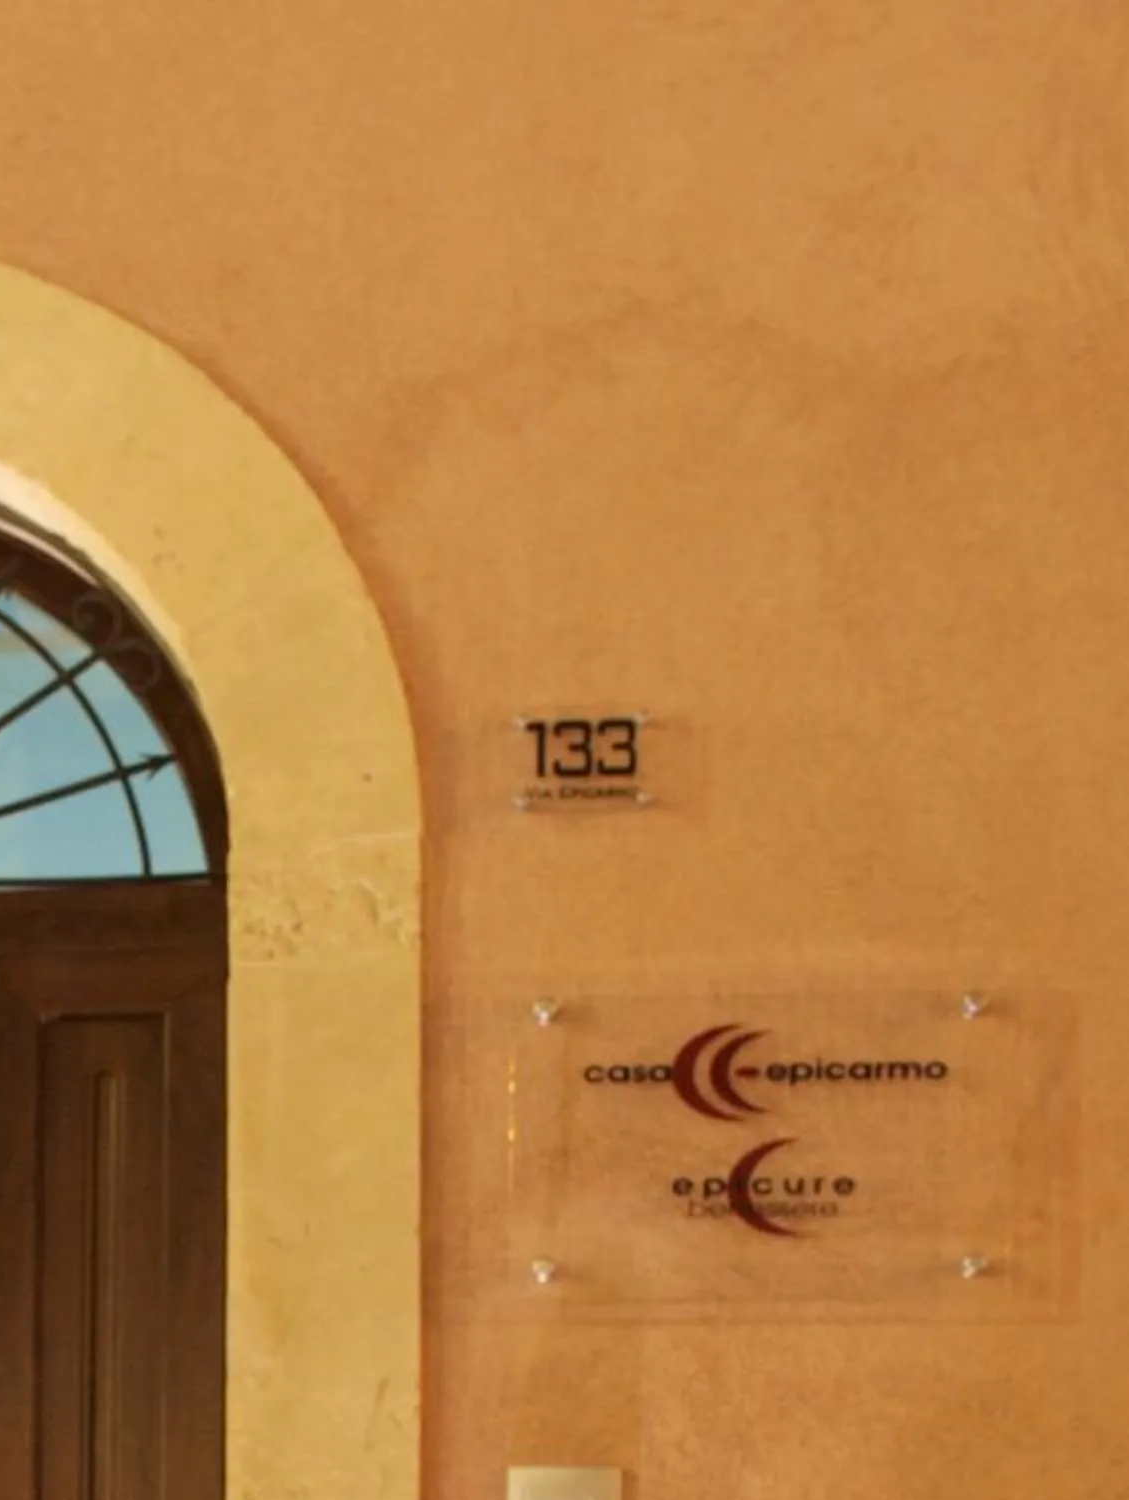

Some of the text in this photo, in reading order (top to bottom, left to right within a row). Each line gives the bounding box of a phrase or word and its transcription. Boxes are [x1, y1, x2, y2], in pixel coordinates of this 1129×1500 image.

[525, 718, 638, 778] 133
[584, 1056, 948, 1087] casa epicarmo
[672, 1174, 857, 1201] epicure
